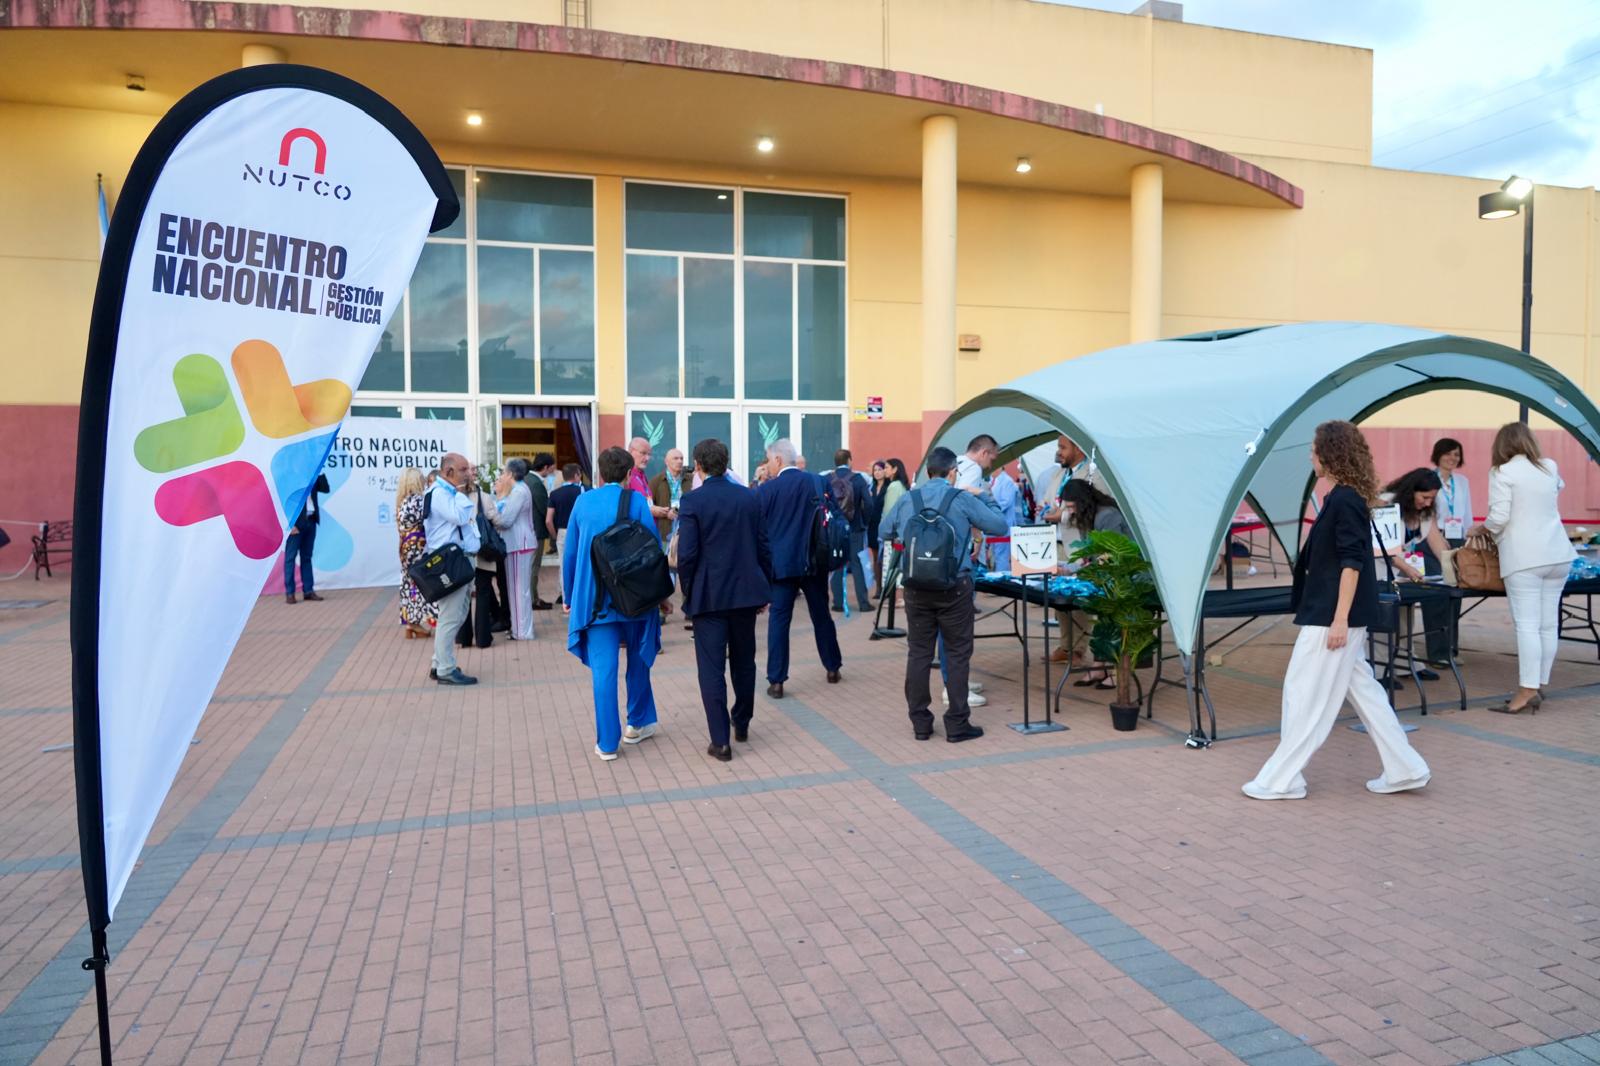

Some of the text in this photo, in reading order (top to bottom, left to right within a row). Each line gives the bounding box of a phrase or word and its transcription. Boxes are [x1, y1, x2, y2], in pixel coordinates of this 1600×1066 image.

[242, 163, 352, 201] NUTCO
[156, 212, 348, 281] ENCUENTRO
[152, 254, 317, 316] NACIONAL
[327, 282, 384, 307] GESTIÓN
[325, 300, 381, 325] PÚBLICA
[369, 437, 448, 453] NACIONAL
[322, 452, 378, 468] STIÓN
